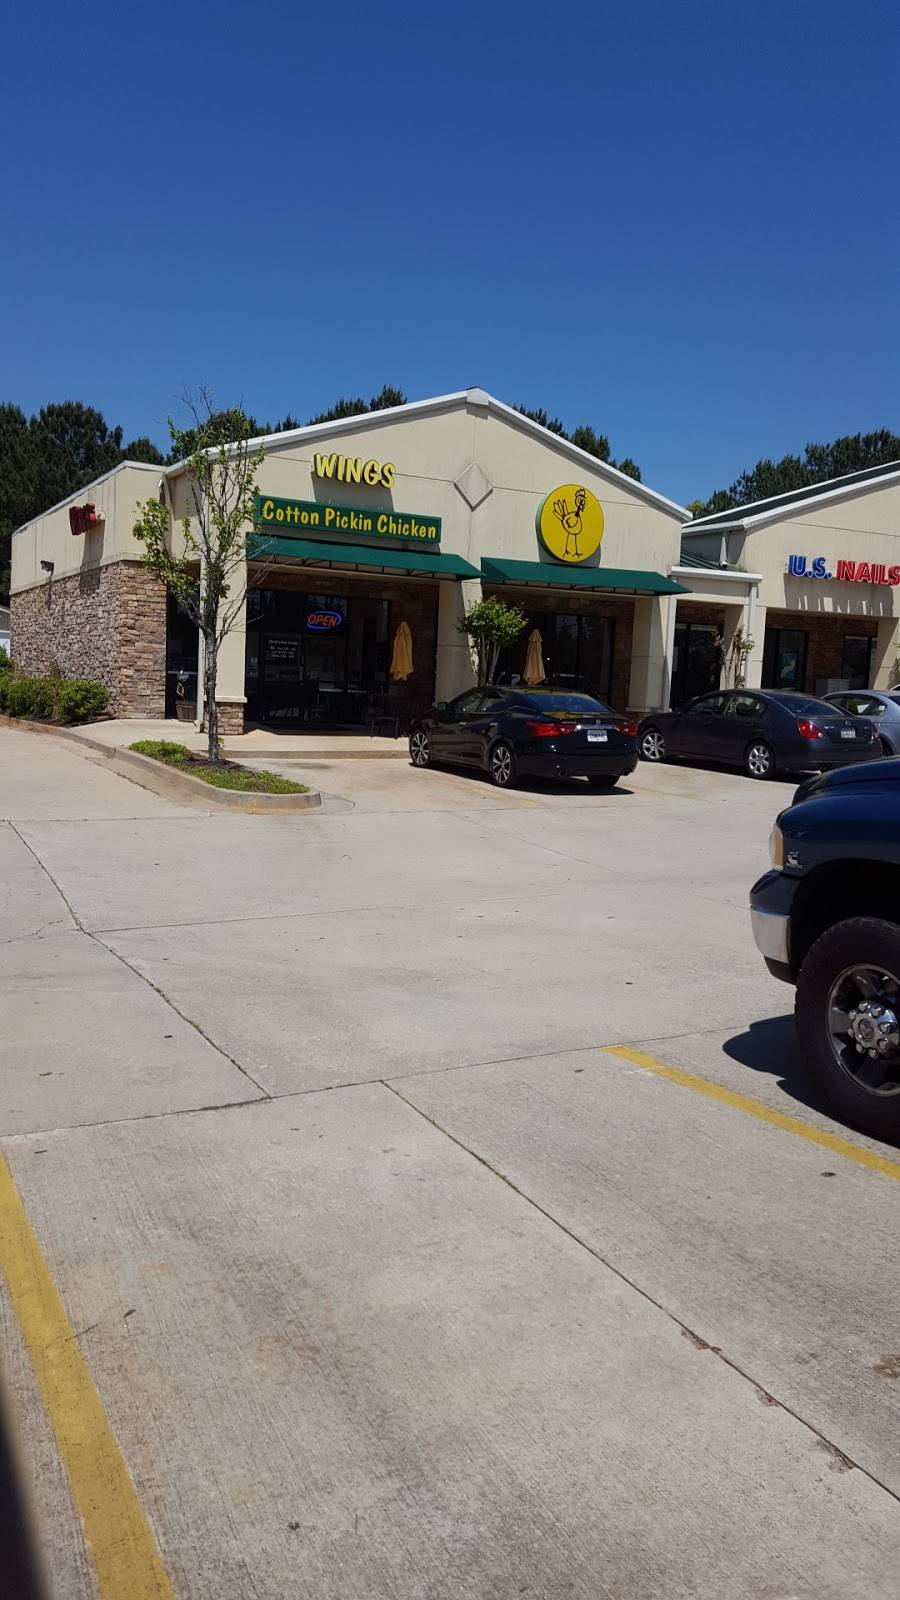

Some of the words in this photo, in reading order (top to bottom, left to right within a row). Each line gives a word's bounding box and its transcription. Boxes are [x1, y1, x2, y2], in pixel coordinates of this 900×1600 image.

[314, 453, 396, 488] WINGS
[262, 500, 319, 525] Cotton
[325, 507, 372, 531] Pickin
[376, 514, 436, 538] Chicken
[788, 554, 832, 579] U.S.
[836, 559, 900, 586] NAILS
[307, 613, 338, 627] OPEN
